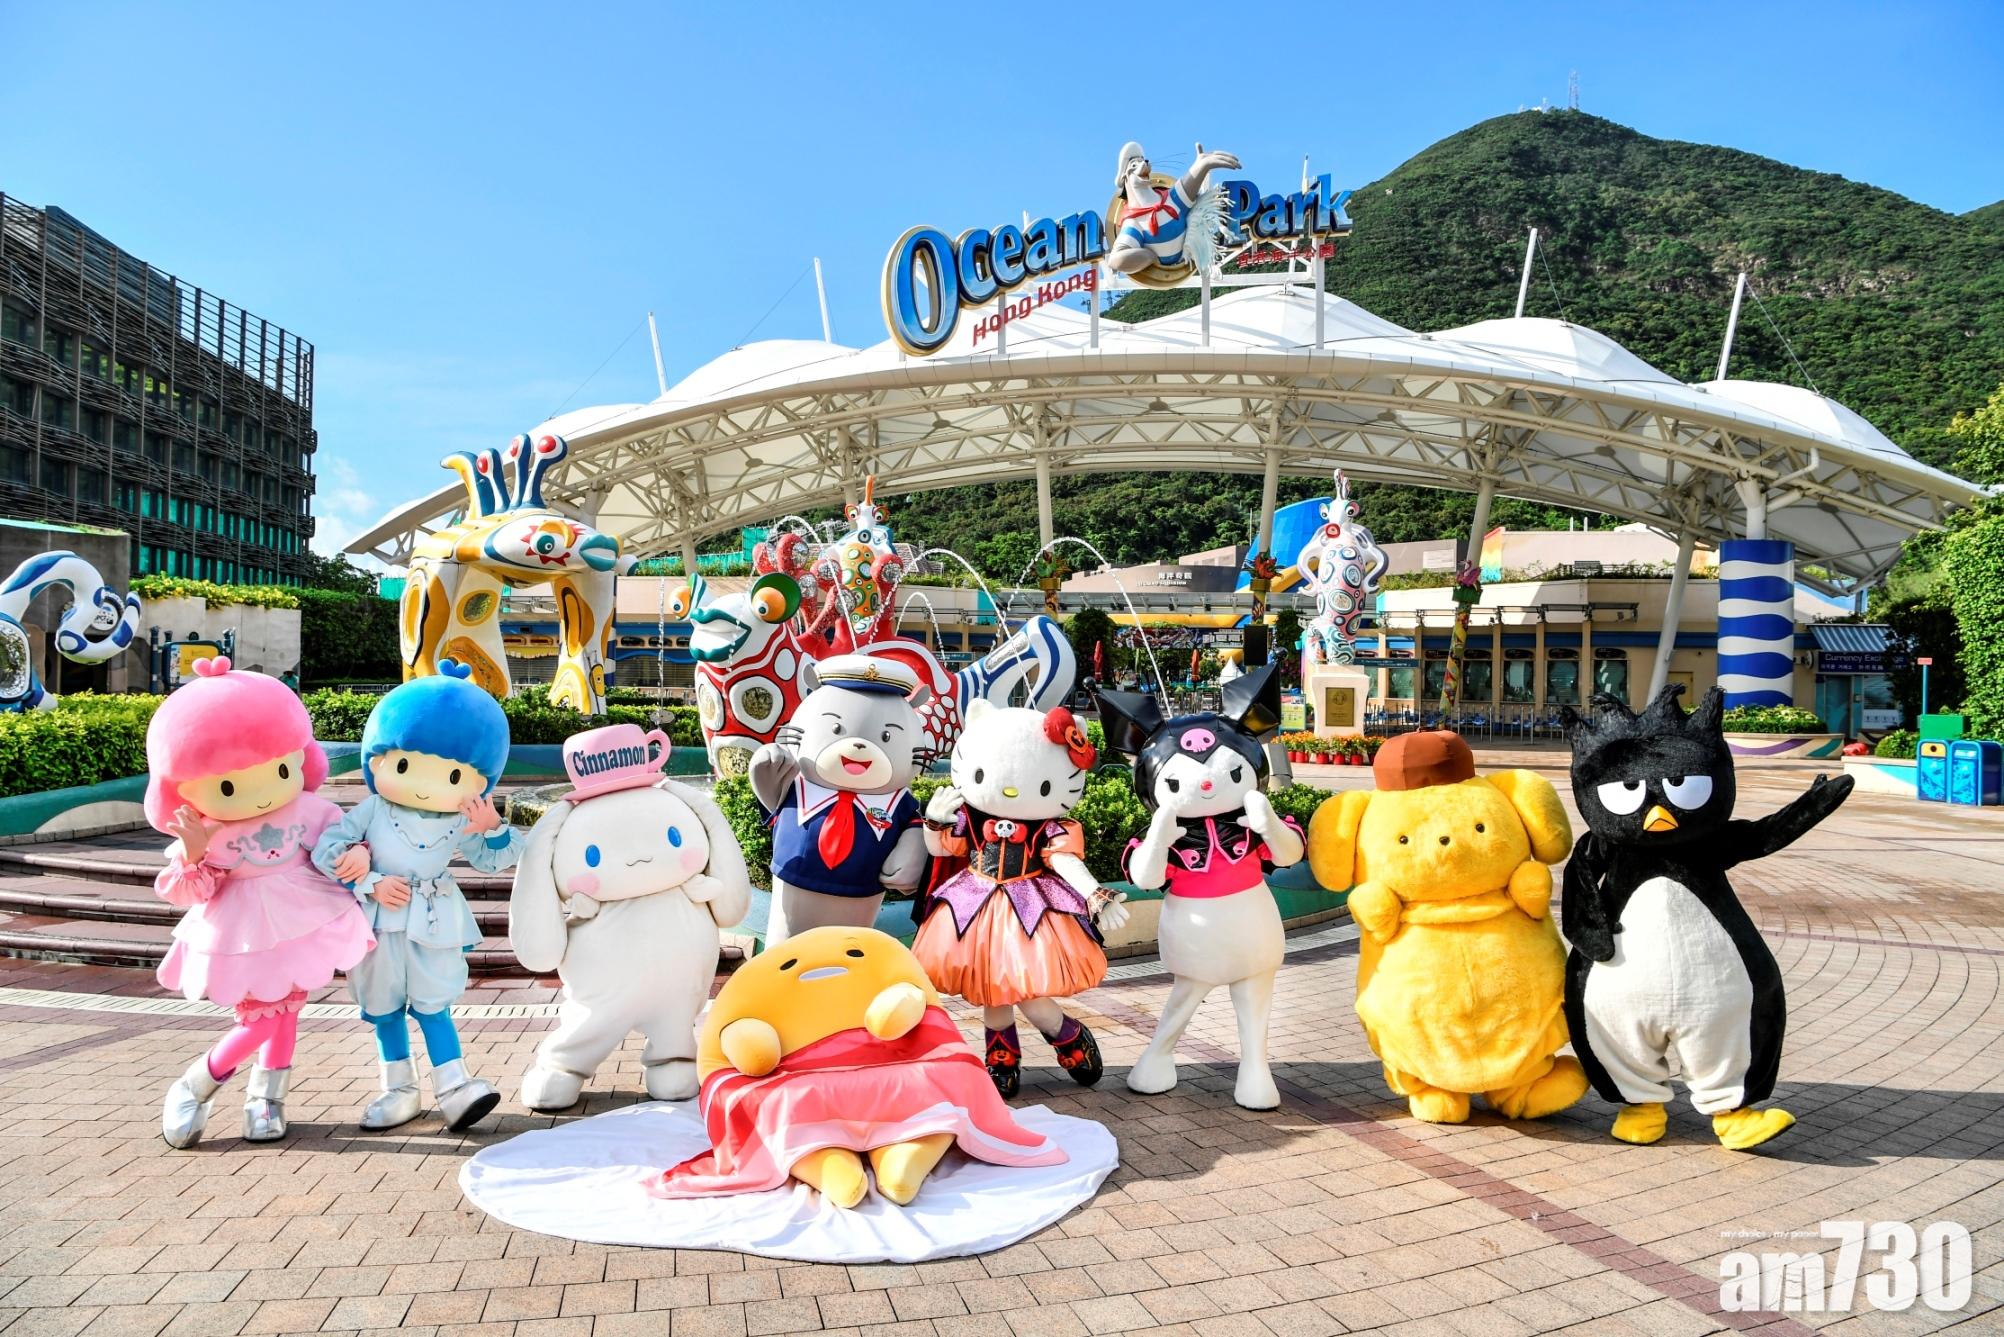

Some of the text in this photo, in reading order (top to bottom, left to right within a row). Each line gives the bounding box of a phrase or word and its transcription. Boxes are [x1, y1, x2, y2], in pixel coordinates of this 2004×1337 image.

[882, 173, 1353, 356] Ocean Park
[972, 268, 1097, 347] Hong Kong
[1825, 653, 1863, 664] Currency
[572, 745, 646, 777] Cinnamon
